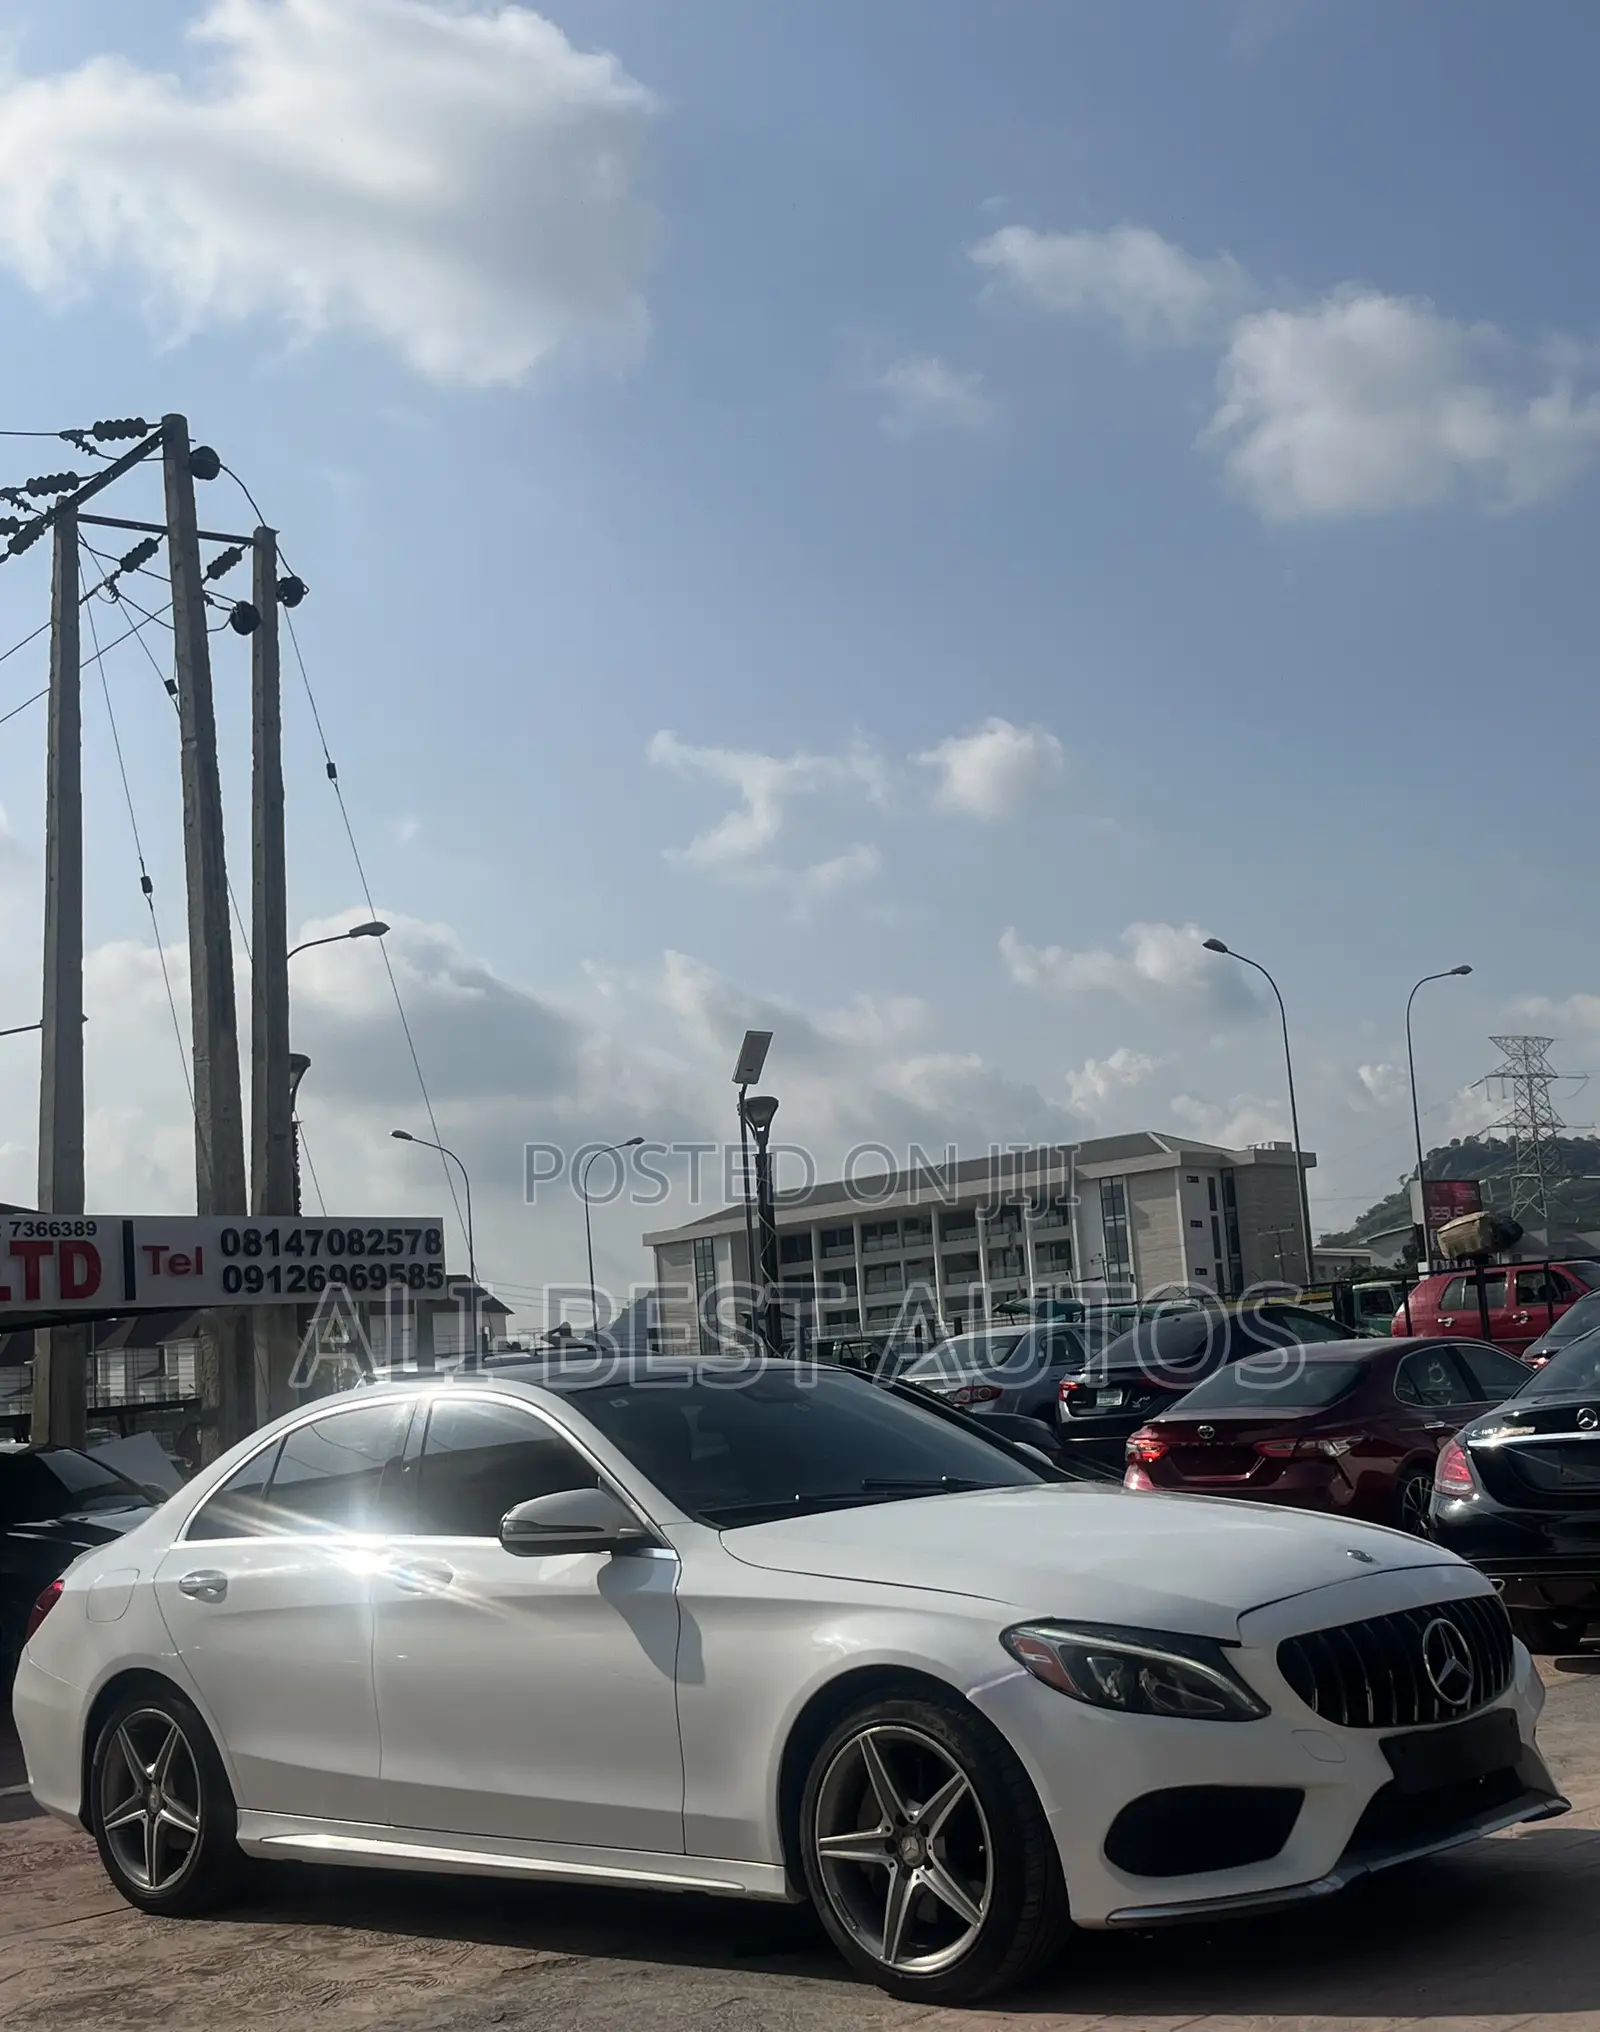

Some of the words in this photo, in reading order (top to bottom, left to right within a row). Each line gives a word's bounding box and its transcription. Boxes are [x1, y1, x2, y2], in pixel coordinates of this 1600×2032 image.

[8, 1220, 98, 1238] 7366389
[220, 1227, 442, 1257] 08147082578
[0, 1240, 102, 1301] TD
[142, 1245, 204, 1276] Tel
[222, 1262, 444, 1294] 09126969585
